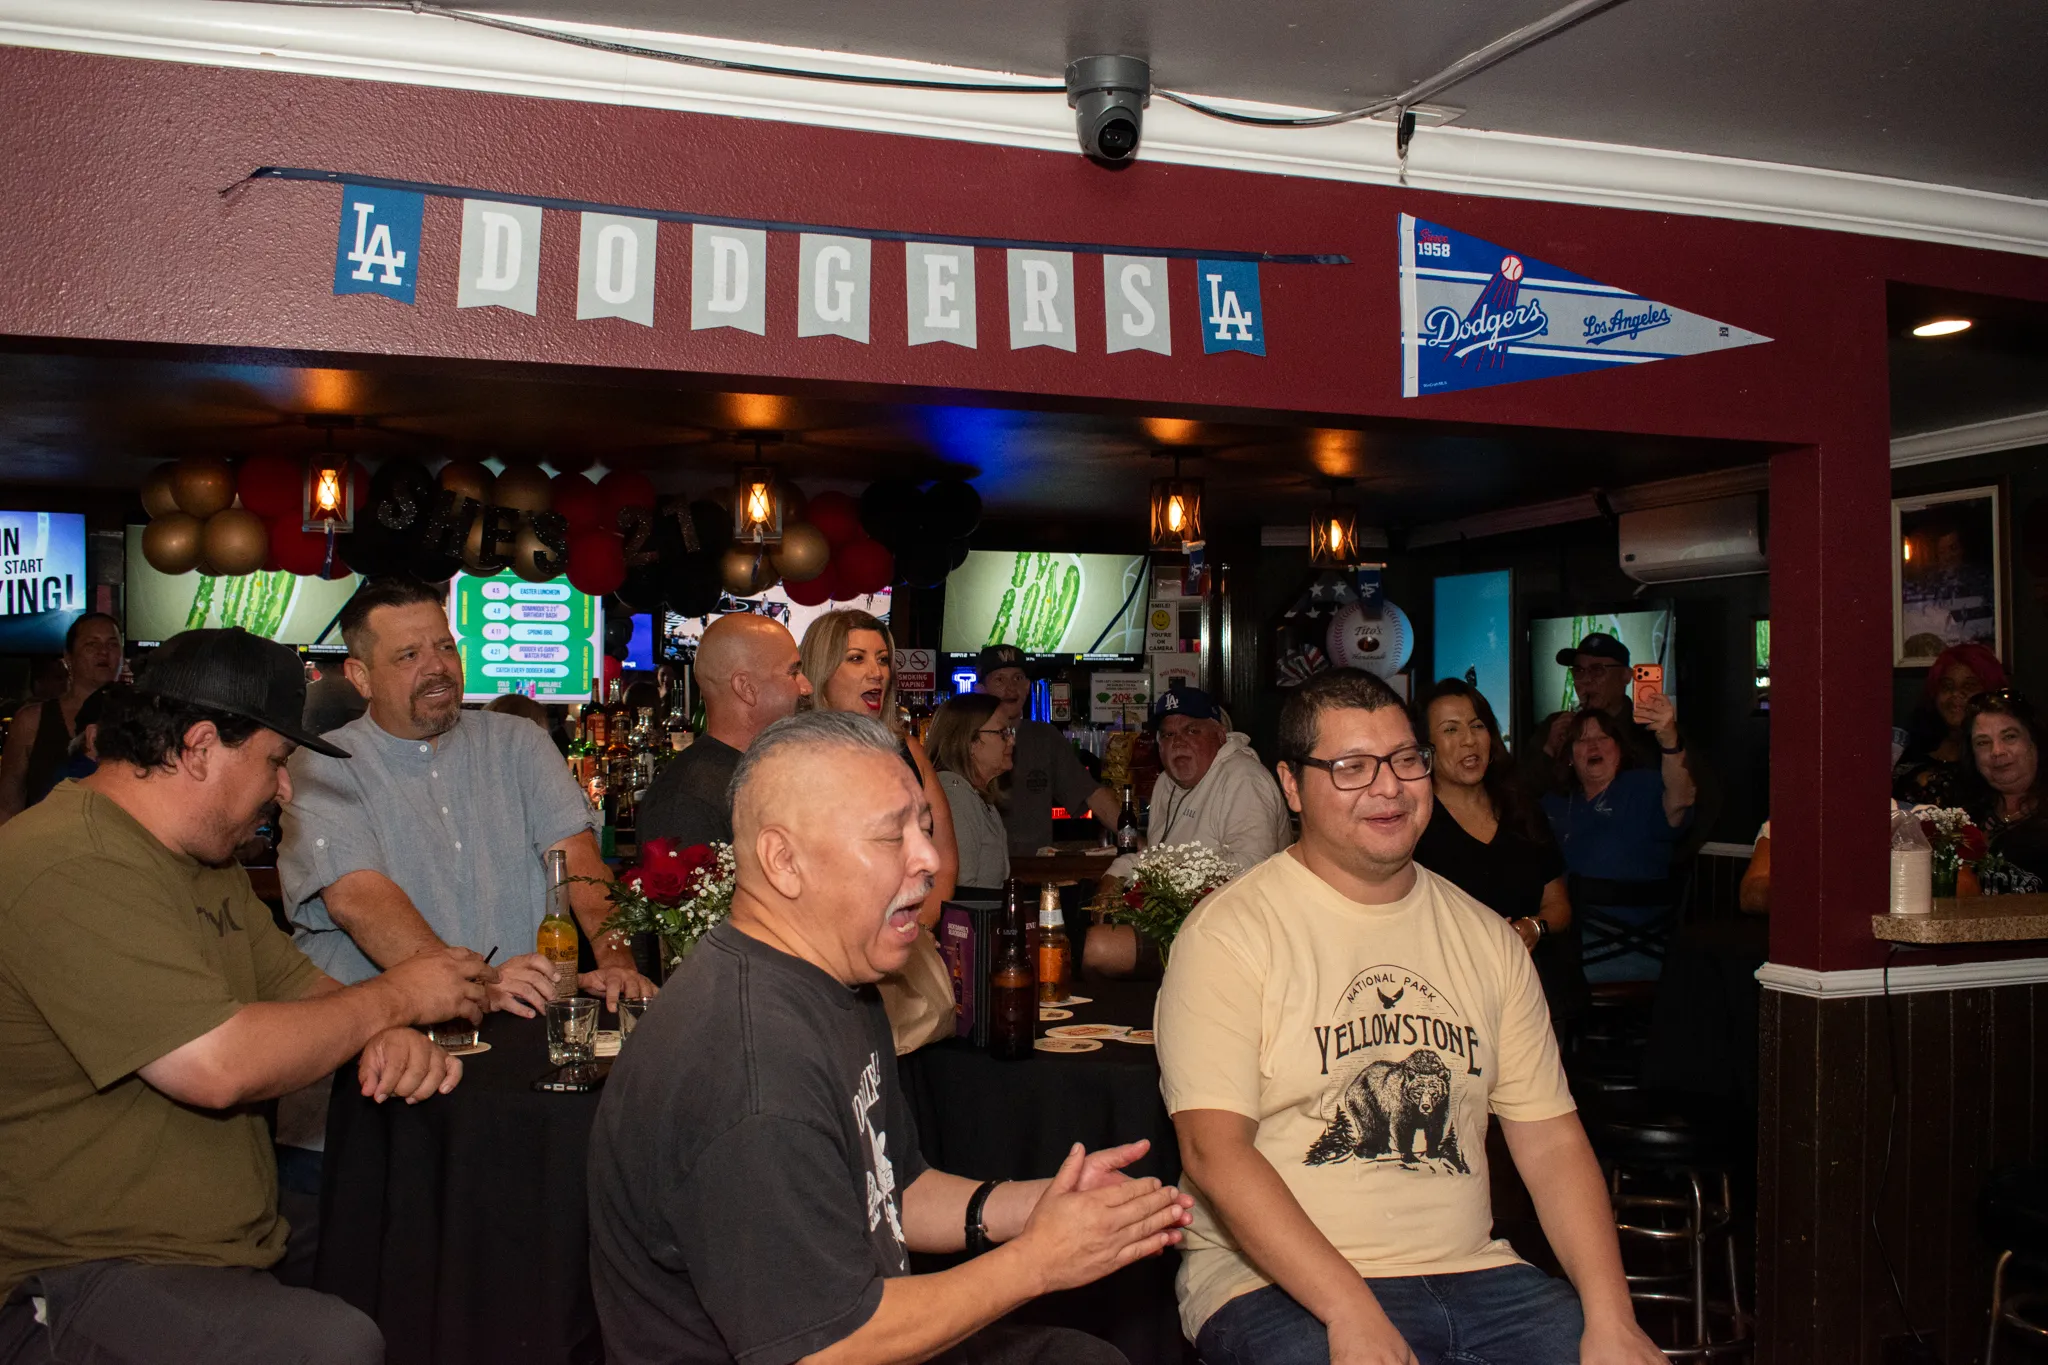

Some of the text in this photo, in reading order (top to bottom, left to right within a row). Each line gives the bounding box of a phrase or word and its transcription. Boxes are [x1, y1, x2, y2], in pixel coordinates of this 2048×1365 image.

[1418, 227, 1449, 244] Since
[1417, 242, 1451, 258] 1958
[347, 202, 1253, 341] LA DODGERS LA
[1426, 299, 1547, 358] Dodgers
[1582, 305, 1672, 339] Los Angeles
[4, 558, 44, 575] START
[1354, 625, 1382, 636] Tito's
[898, 673, 928, 681] SMOKING
[1111, 692, 1133, 705] 20%
[1164, 693, 1179, 711] LA
[1025, 921, 1037, 930] ENU
[1346, 972, 1436, 1004] NATIONAL PARK
[1313, 1012, 1483, 1077] YELLOWSTONE
